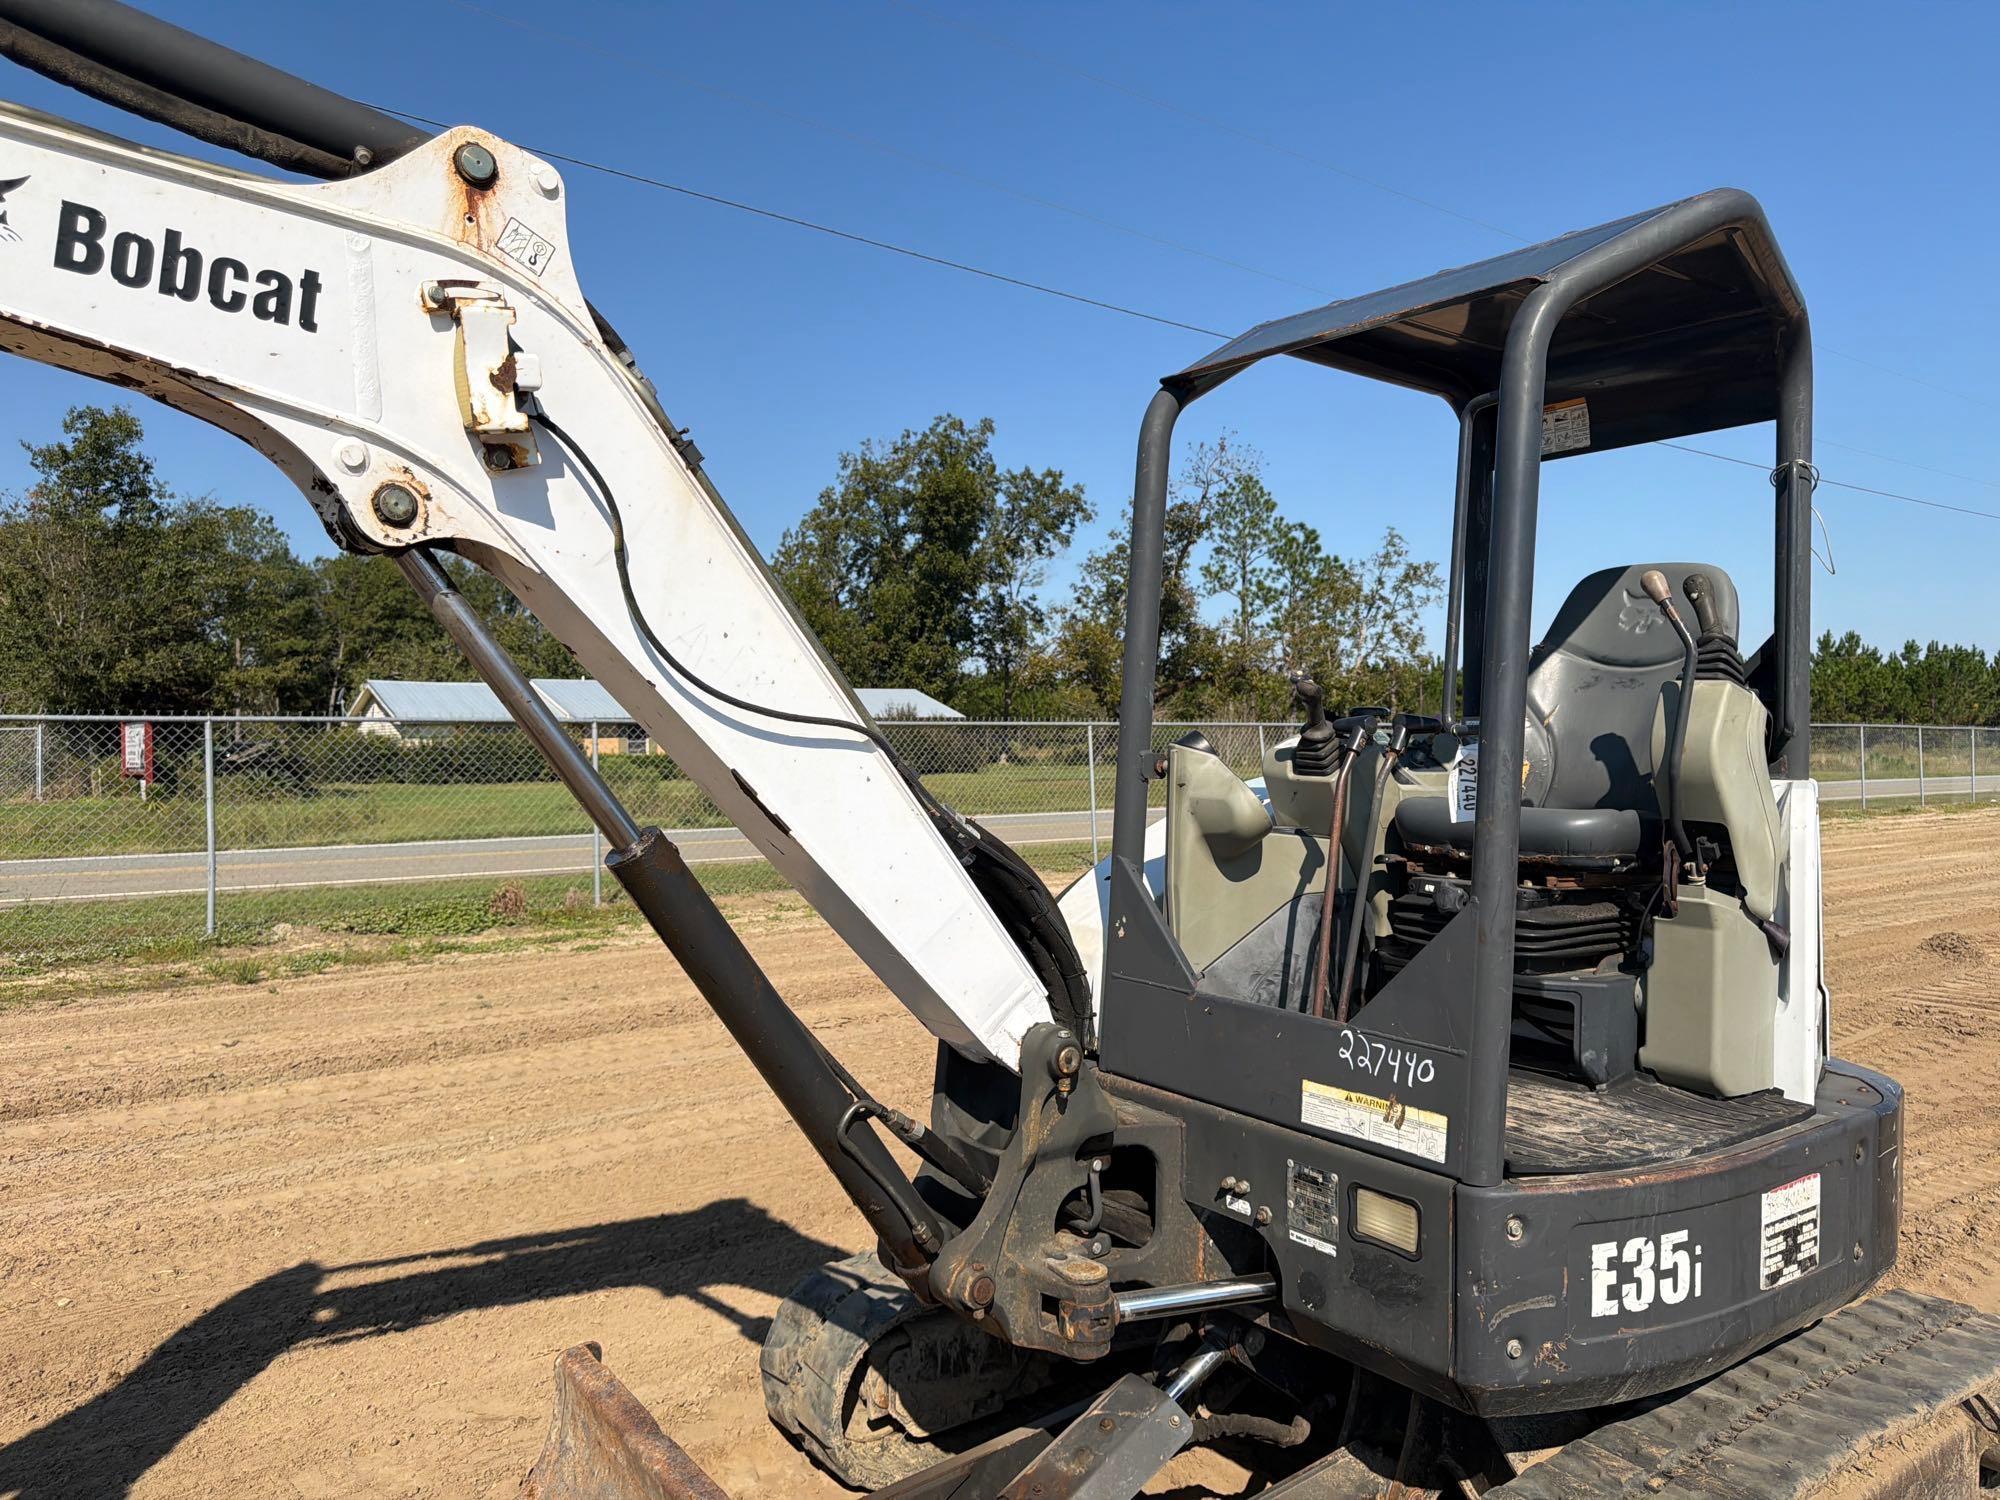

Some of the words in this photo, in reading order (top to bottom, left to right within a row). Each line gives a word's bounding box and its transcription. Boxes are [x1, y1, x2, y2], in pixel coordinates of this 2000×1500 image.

[54, 199, 322, 333] Bobcat
[1338, 1029, 1435, 1087] 227440
[1591, 1229, 1701, 1317] E35i
